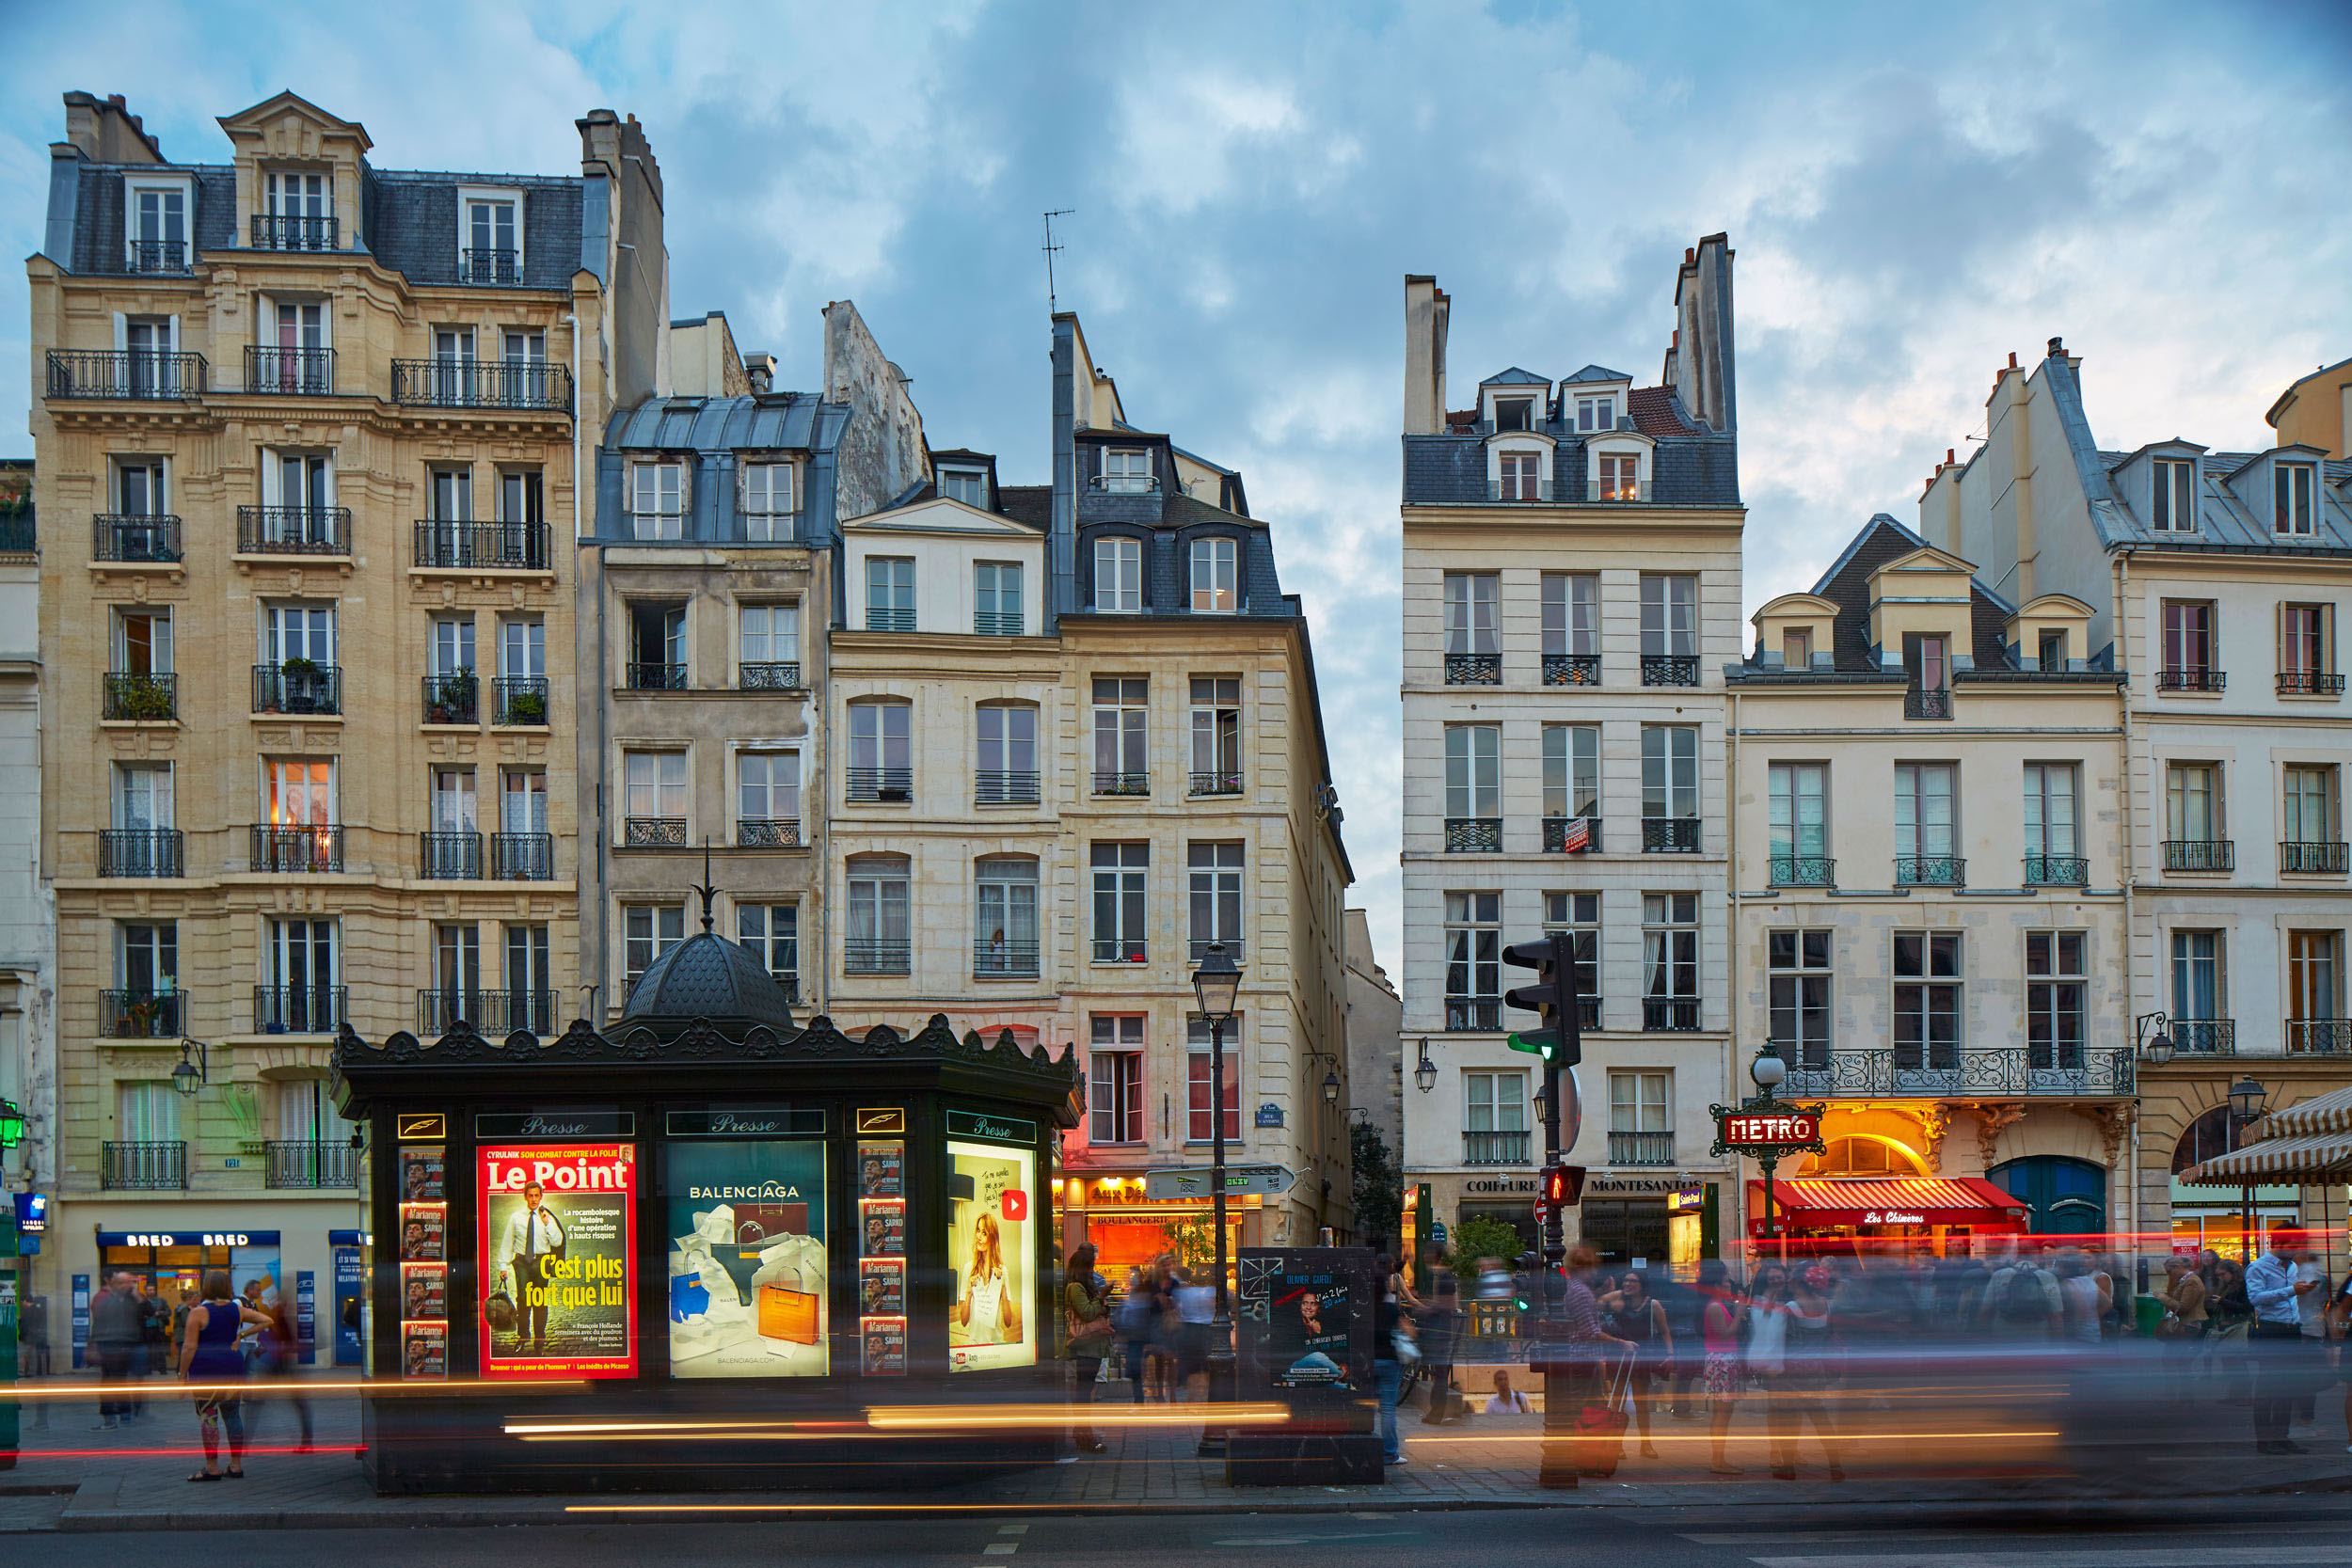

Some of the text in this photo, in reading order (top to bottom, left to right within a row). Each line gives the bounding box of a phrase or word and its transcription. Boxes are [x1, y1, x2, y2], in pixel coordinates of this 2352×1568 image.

[1571, 832, 1587, 845] LOUER
[521, 1116, 588, 1135] Presse
[711, 1114, 780, 1132] Presse
[974, 1117, 1012, 1137] Presse
[1731, 1119, 1810, 1140] METRO
[487, 1158, 628, 1189] Le Point
[690, 1186, 799, 1198] BALENCIAGA
[1467, 1180, 1702, 1192] COIFFURE MONTESANTOS
[1092, 1187, 1123, 1198] Aux
[1680, 1192, 1700, 1205] Saint-Paul
[409, 1208, 441, 1219] Marianne
[572, 1208, 620, 1217] rocambolesque
[867, 1204, 900, 1215] Marianne
[1097, 1216, 1169, 1224] BOULANGERIE
[1865, 1212, 1924, 1223] Les Chimères
[586, 1224, 617, 1233] opération
[127, 1234, 249, 1247] BRED BRED
[409, 1267, 442, 1277] Marianne
[540, 1254, 623, 1283] C'est plus
[866, 1262, 898, 1273] Marianne
[1286, 1275, 1332, 1284] OLIVIER GUEDJ
[525, 1281, 622, 1310] fort que lui
[1330, 1290, 1336, 1298] 2
[1336, 1286, 1348, 1297] fois
[1323, 1299, 1332, 1309] 20
[409, 1324, 443, 1336] Marianne
[867, 1322, 901, 1332] Marianne
[885, 1337, 903, 1345] SARKO
